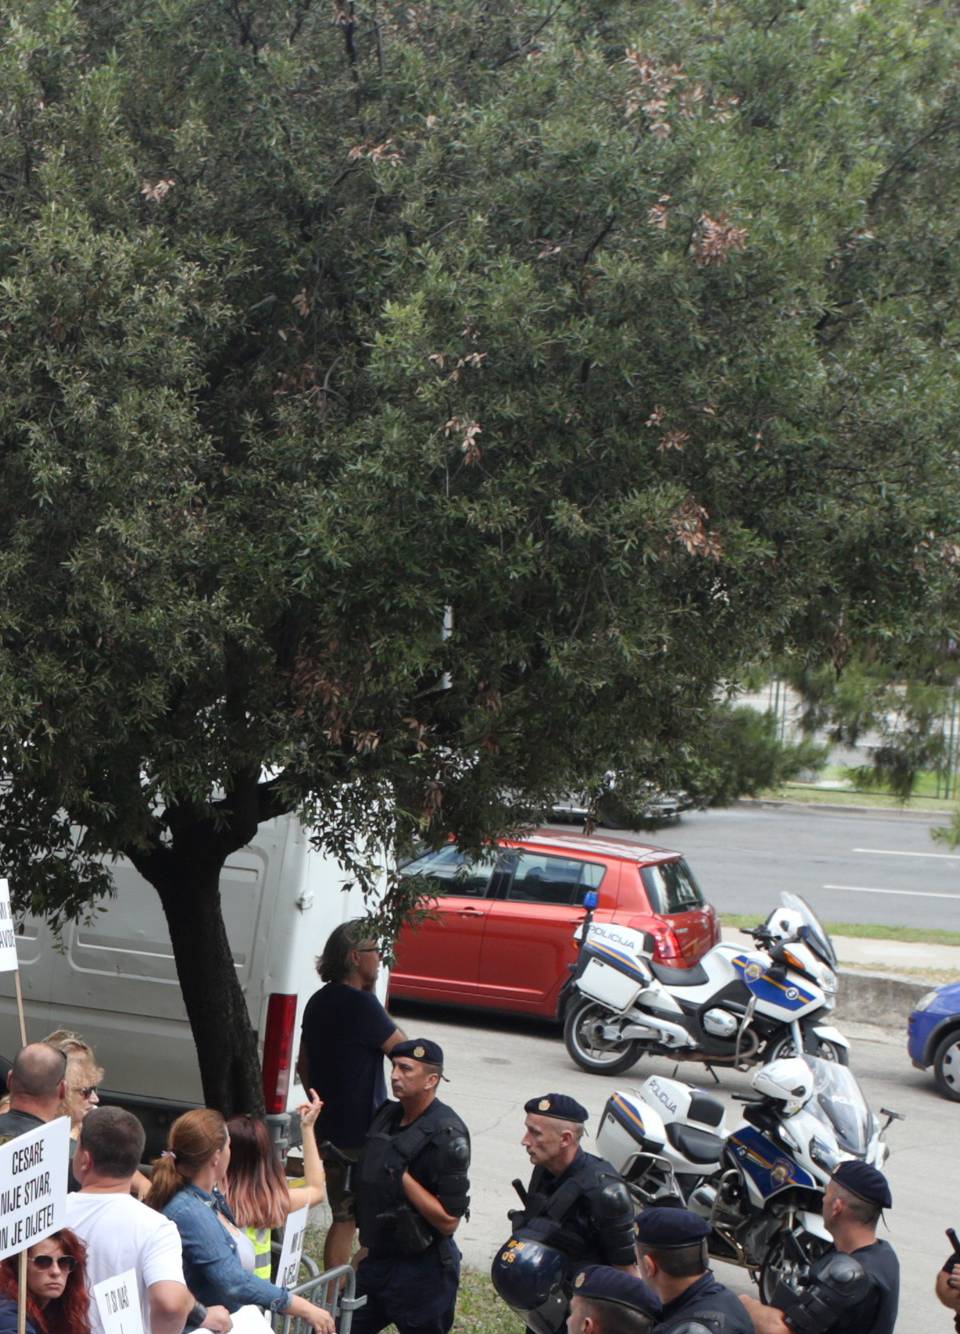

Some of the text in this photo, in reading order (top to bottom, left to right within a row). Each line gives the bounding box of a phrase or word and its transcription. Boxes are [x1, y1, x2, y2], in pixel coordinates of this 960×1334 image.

[589, 926, 635, 949] POLICIJA
[648, 1079, 678, 1114] POLICIJA
[11, 1139, 45, 1176] CESARE
[0, 1171, 52, 1217] NIJE STVAR,
[11, 1219, 23, 1246] JE
[25, 1203, 54, 1240] DIJETE!
